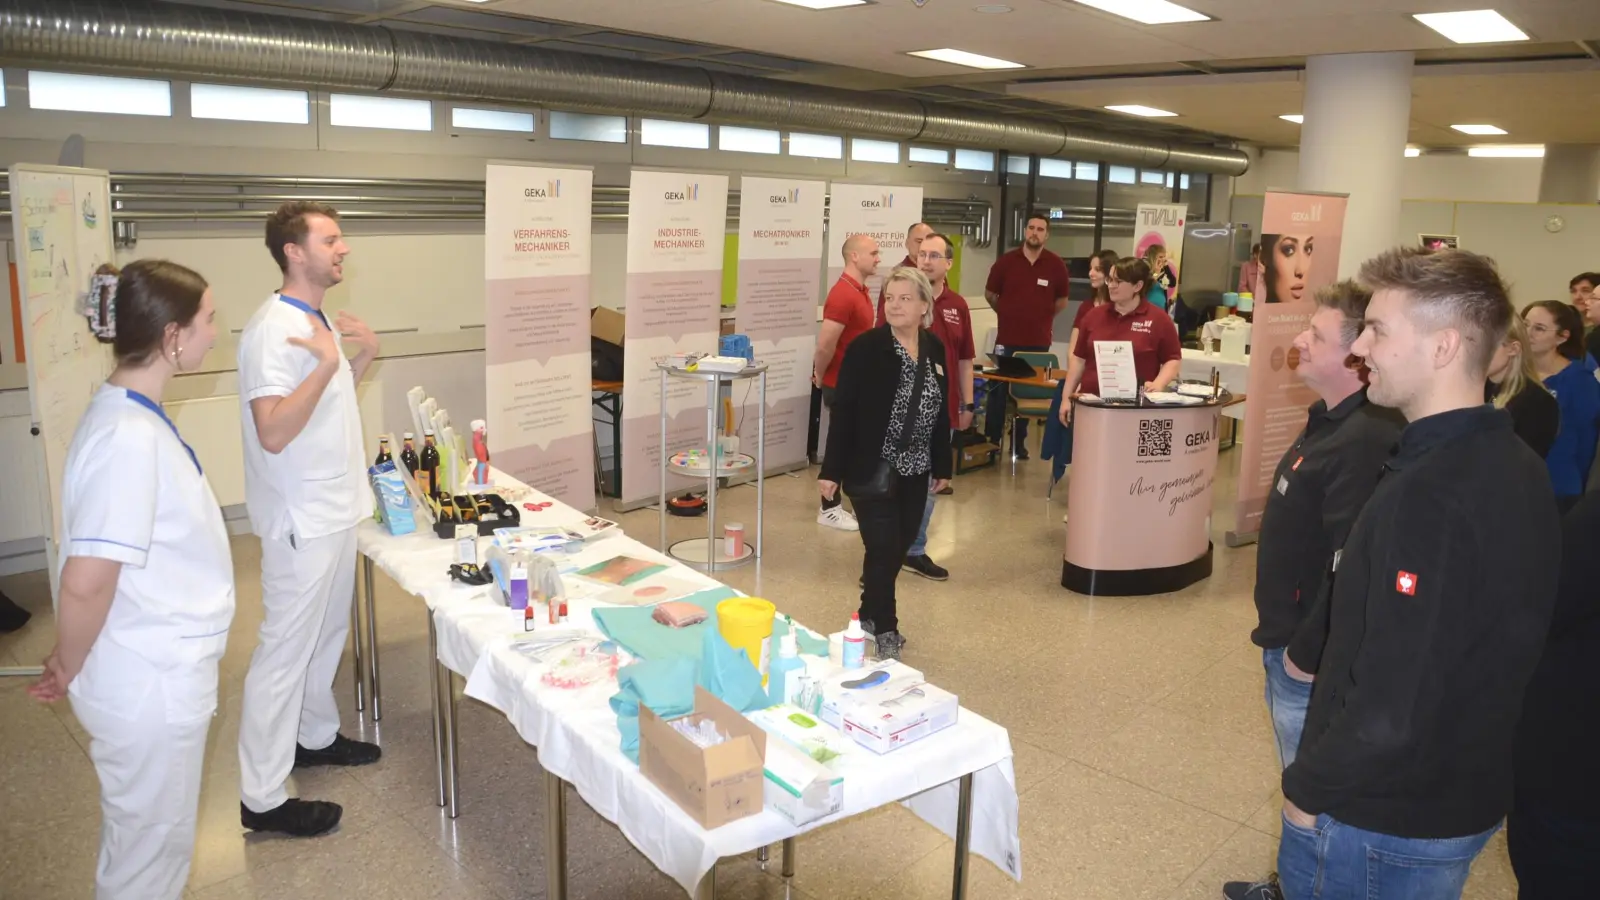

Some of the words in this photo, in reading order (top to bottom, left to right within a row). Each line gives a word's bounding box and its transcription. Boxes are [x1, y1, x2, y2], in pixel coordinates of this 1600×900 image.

[524, 188, 546, 198] GEKA
[664, 192, 685, 200] GEKA
[769, 195, 787, 203] GEKA
[861, 200, 880, 208] GEKA
[1291, 212, 1309, 221] GEKA
[513, 229, 571, 239] VERFAHRENS-
[657, 228, 702, 237] INDUSTRIE-
[753, 230, 811, 239] MECHATRONIKER
[890, 230, 905, 240] FÜR
[514, 241, 570, 252] MECHANIKER
[653, 240, 705, 249] MECHANIKER
[876, 240, 903, 248] OGISTIK
[1185, 430, 1210, 447] GEKA
